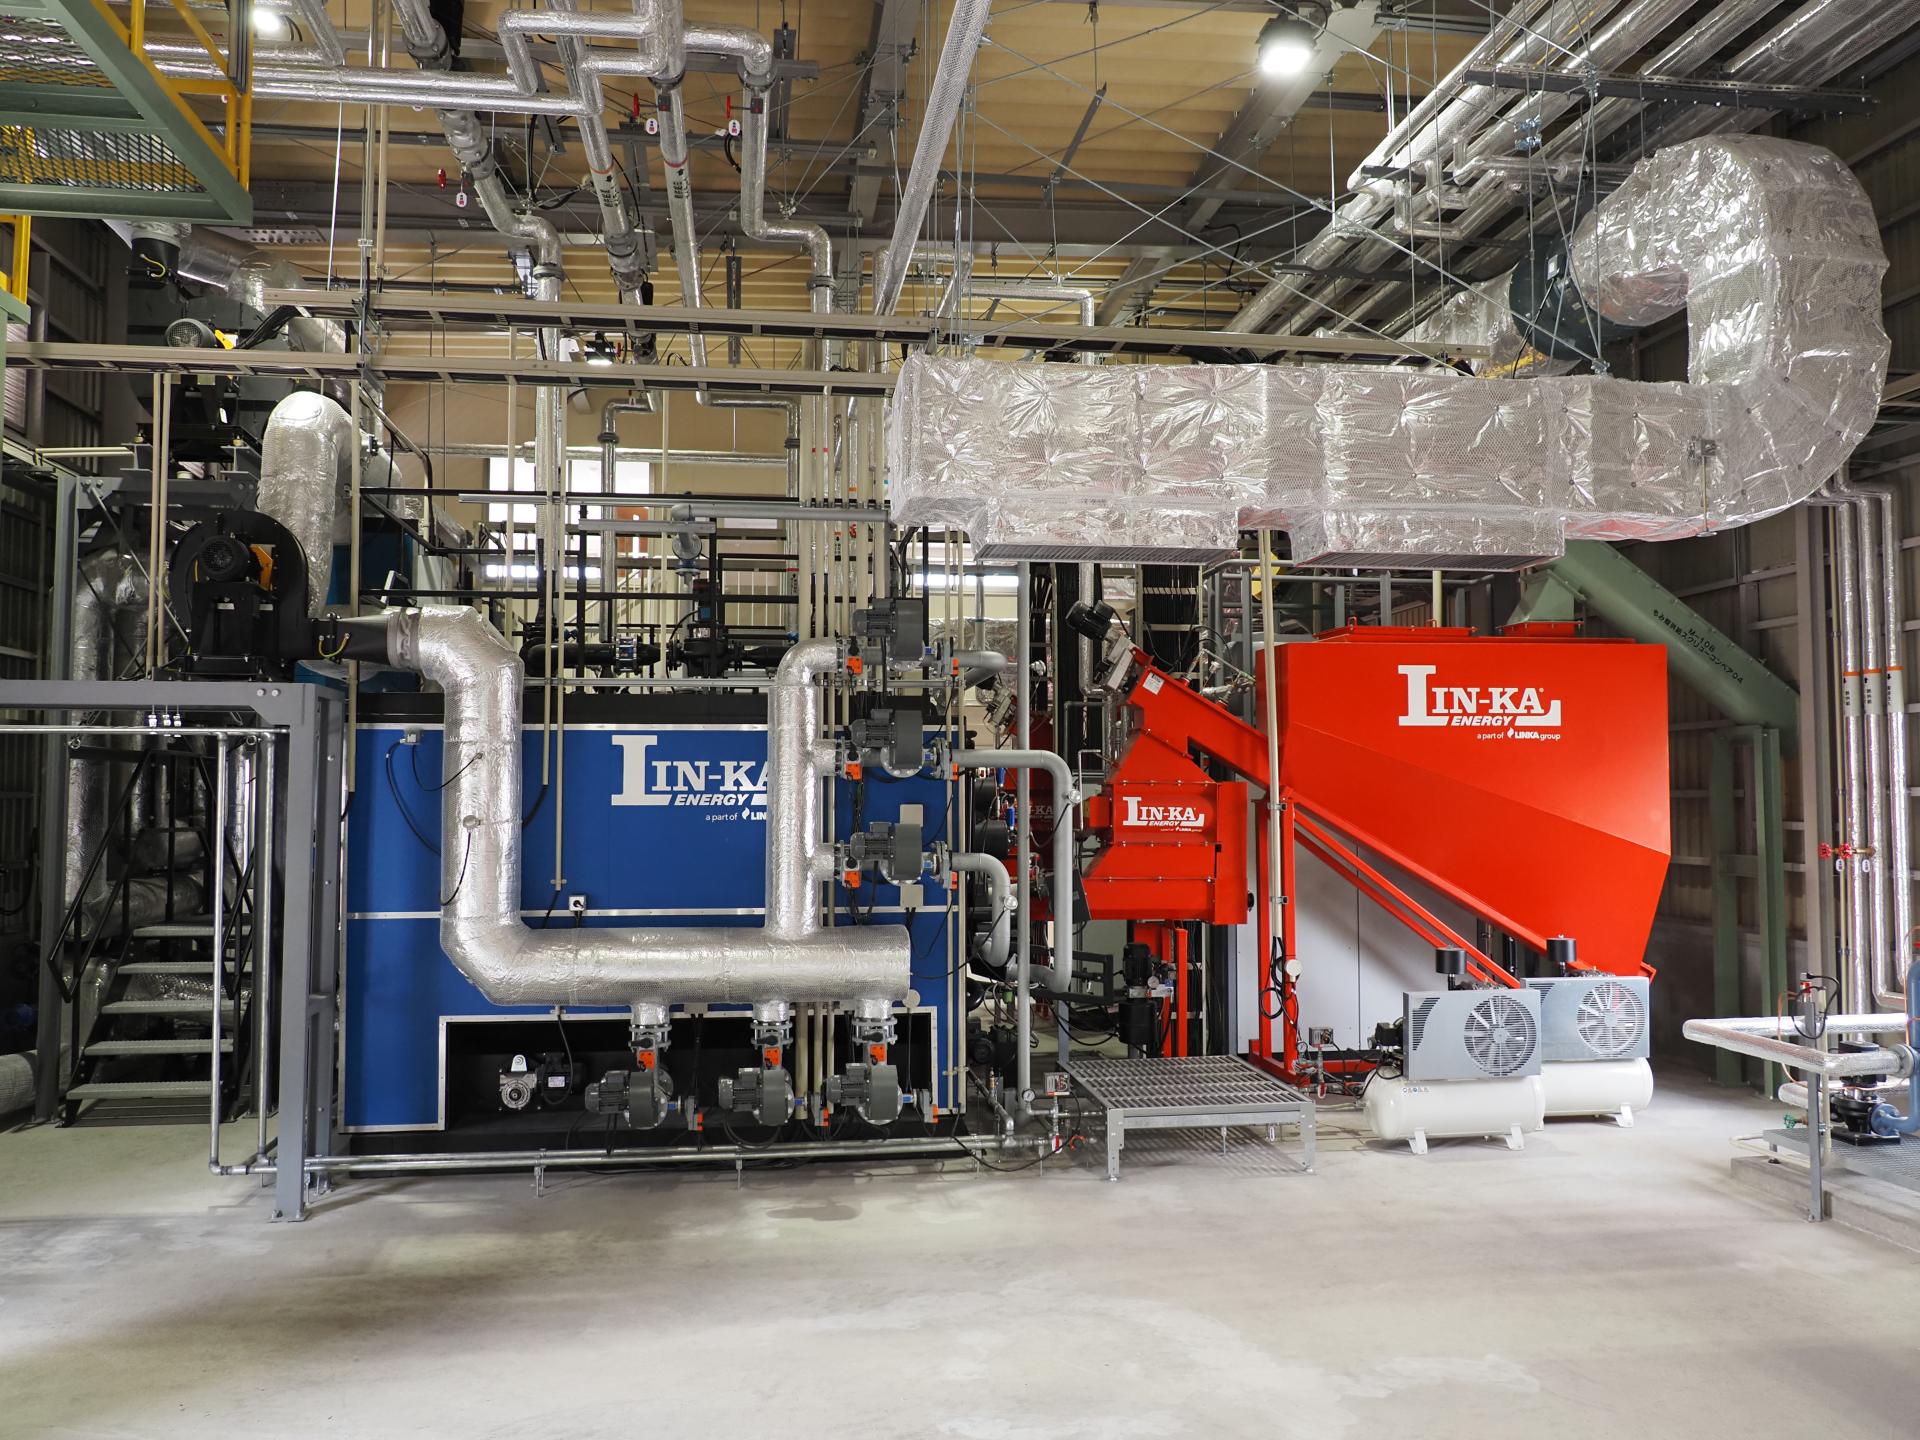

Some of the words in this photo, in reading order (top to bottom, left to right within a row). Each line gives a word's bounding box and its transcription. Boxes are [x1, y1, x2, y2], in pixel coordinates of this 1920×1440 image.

[1398, 665, 1562, 727] LIN-KA
[1451, 716, 1515, 727] ENERGY
[1482, 732, 1497, 741] part
[1497, 731, 1505, 739] of
[1540, 733, 1561, 742] group
[674, 794, 749, 806] ENERGY
[712, 813, 728, 823] part
[729, 812, 738, 821] of
[1123, 797, 1205, 827] LIN-KA
